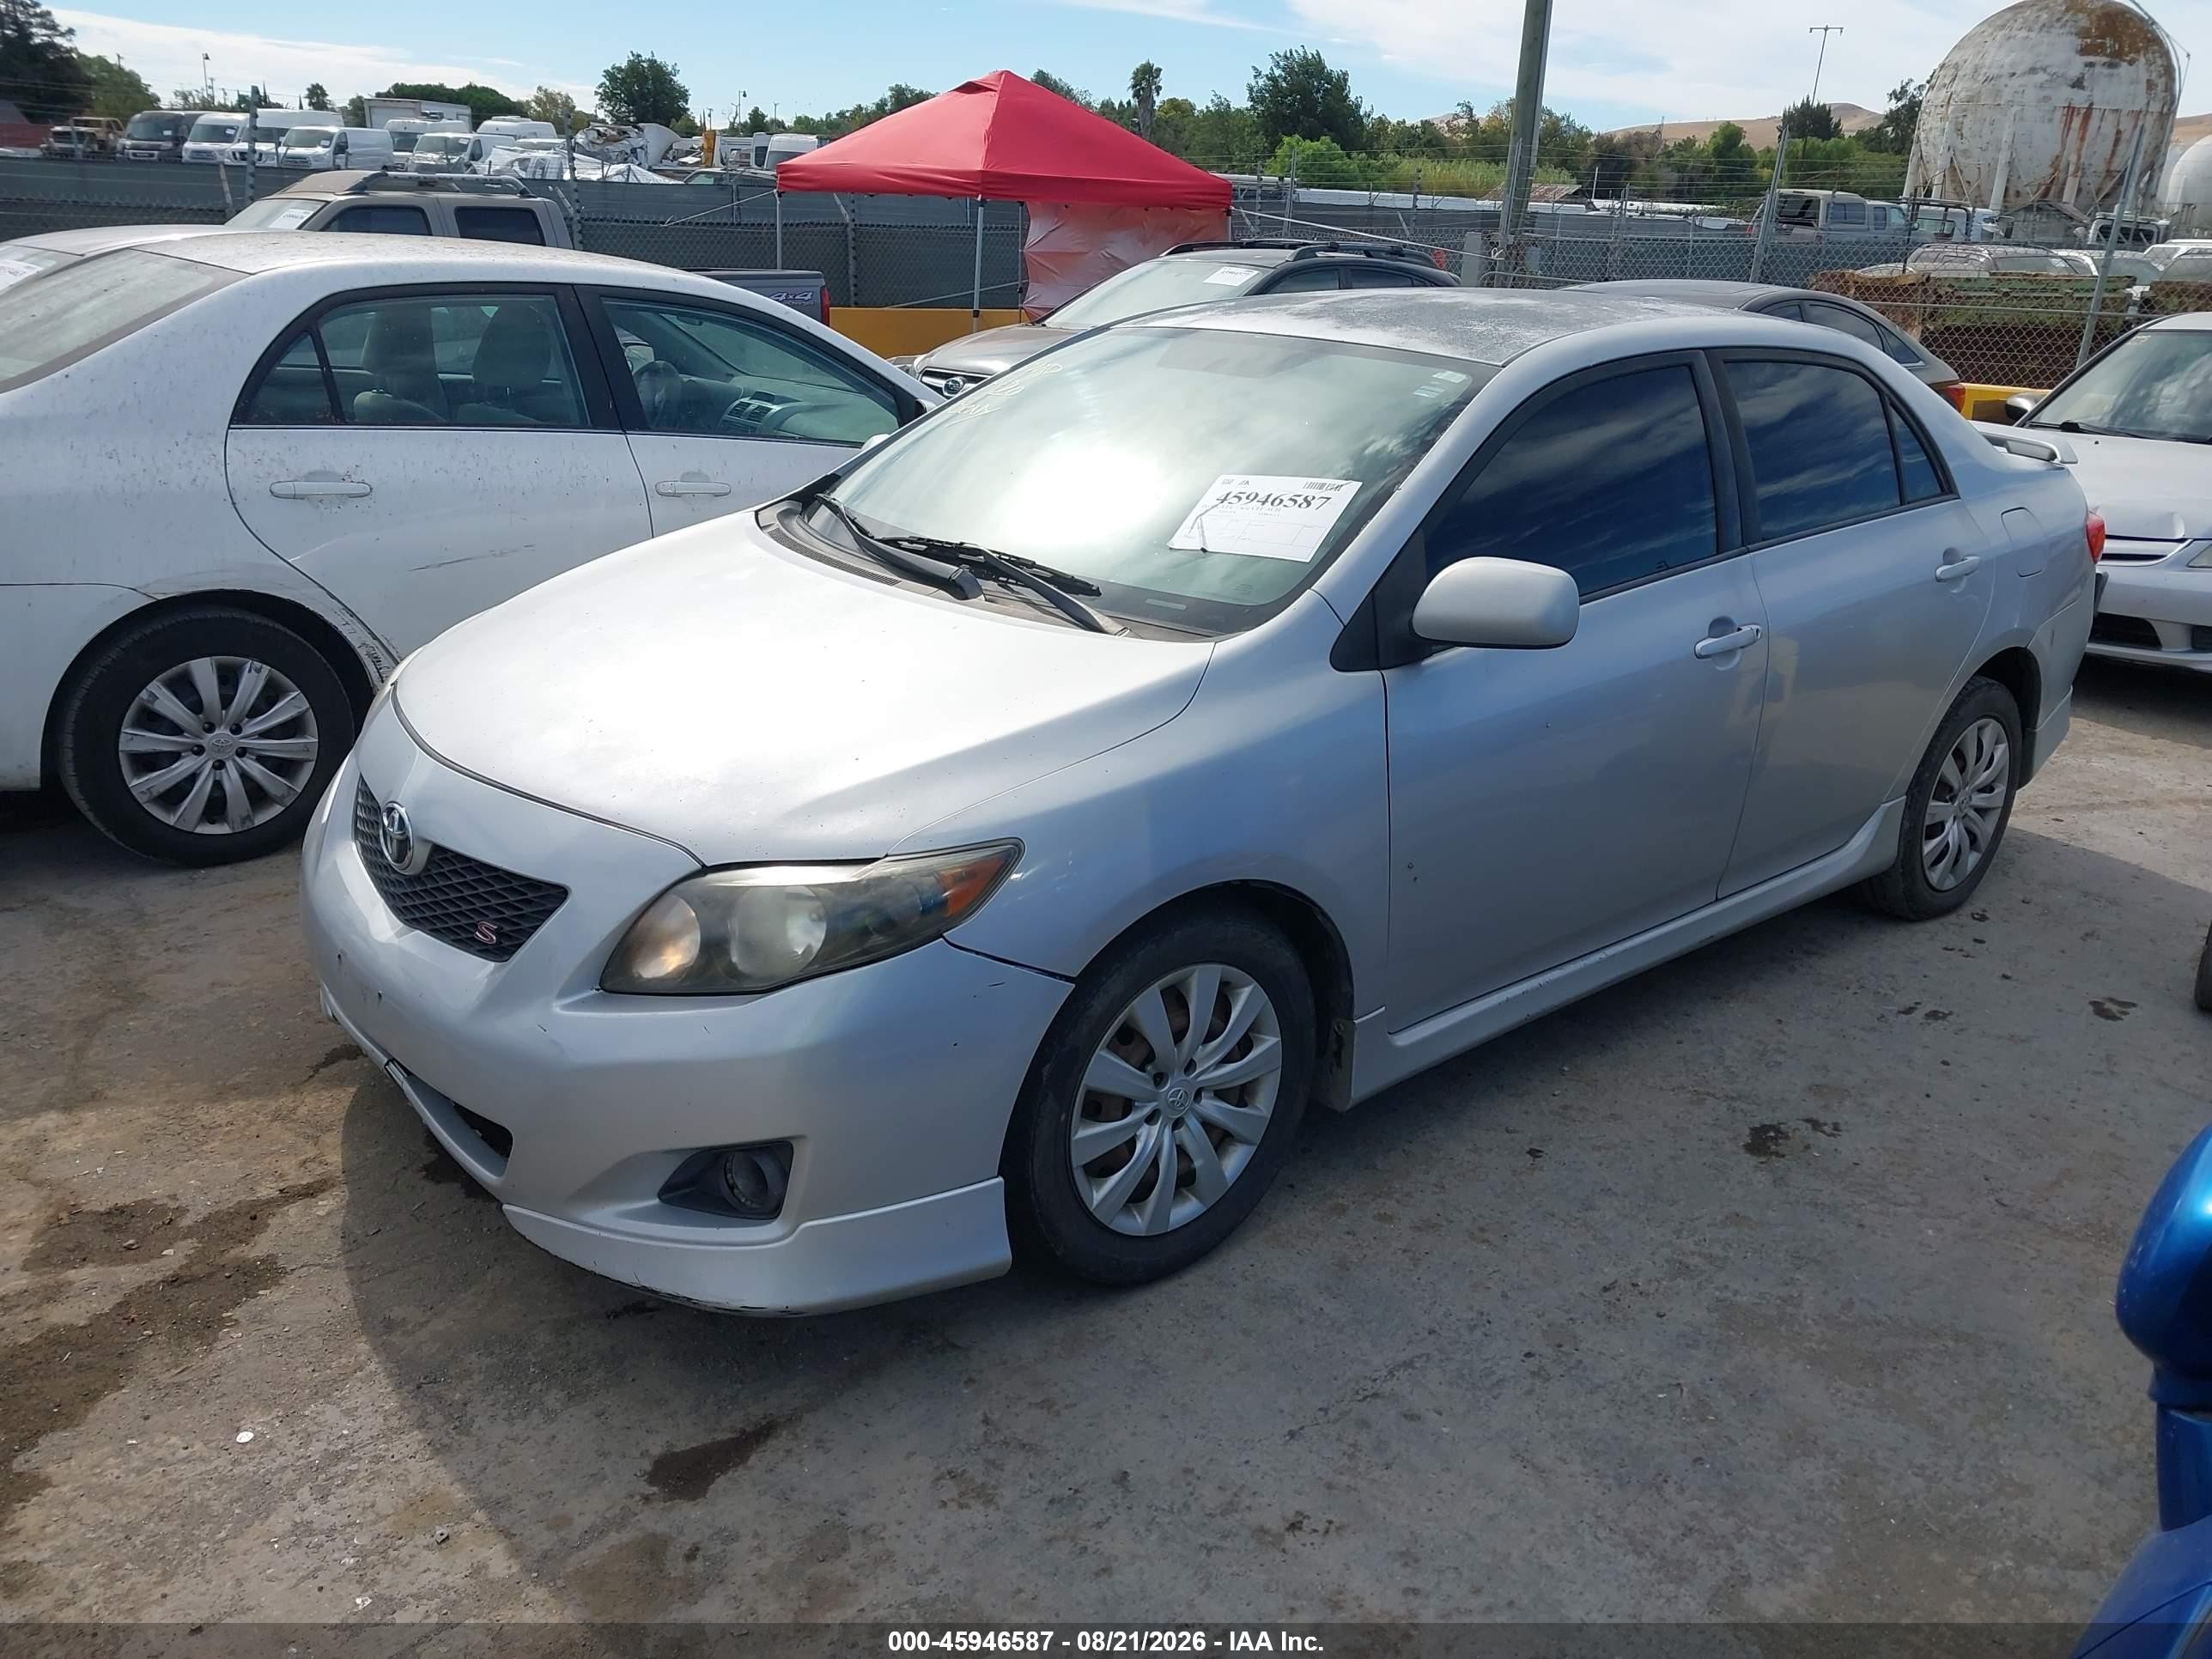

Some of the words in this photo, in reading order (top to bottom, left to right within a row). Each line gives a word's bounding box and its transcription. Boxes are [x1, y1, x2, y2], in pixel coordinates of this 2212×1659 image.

[769, 291, 814, 301] 4x4
[1216, 490, 1333, 511] 45946587
[473, 921, 498, 945] S
